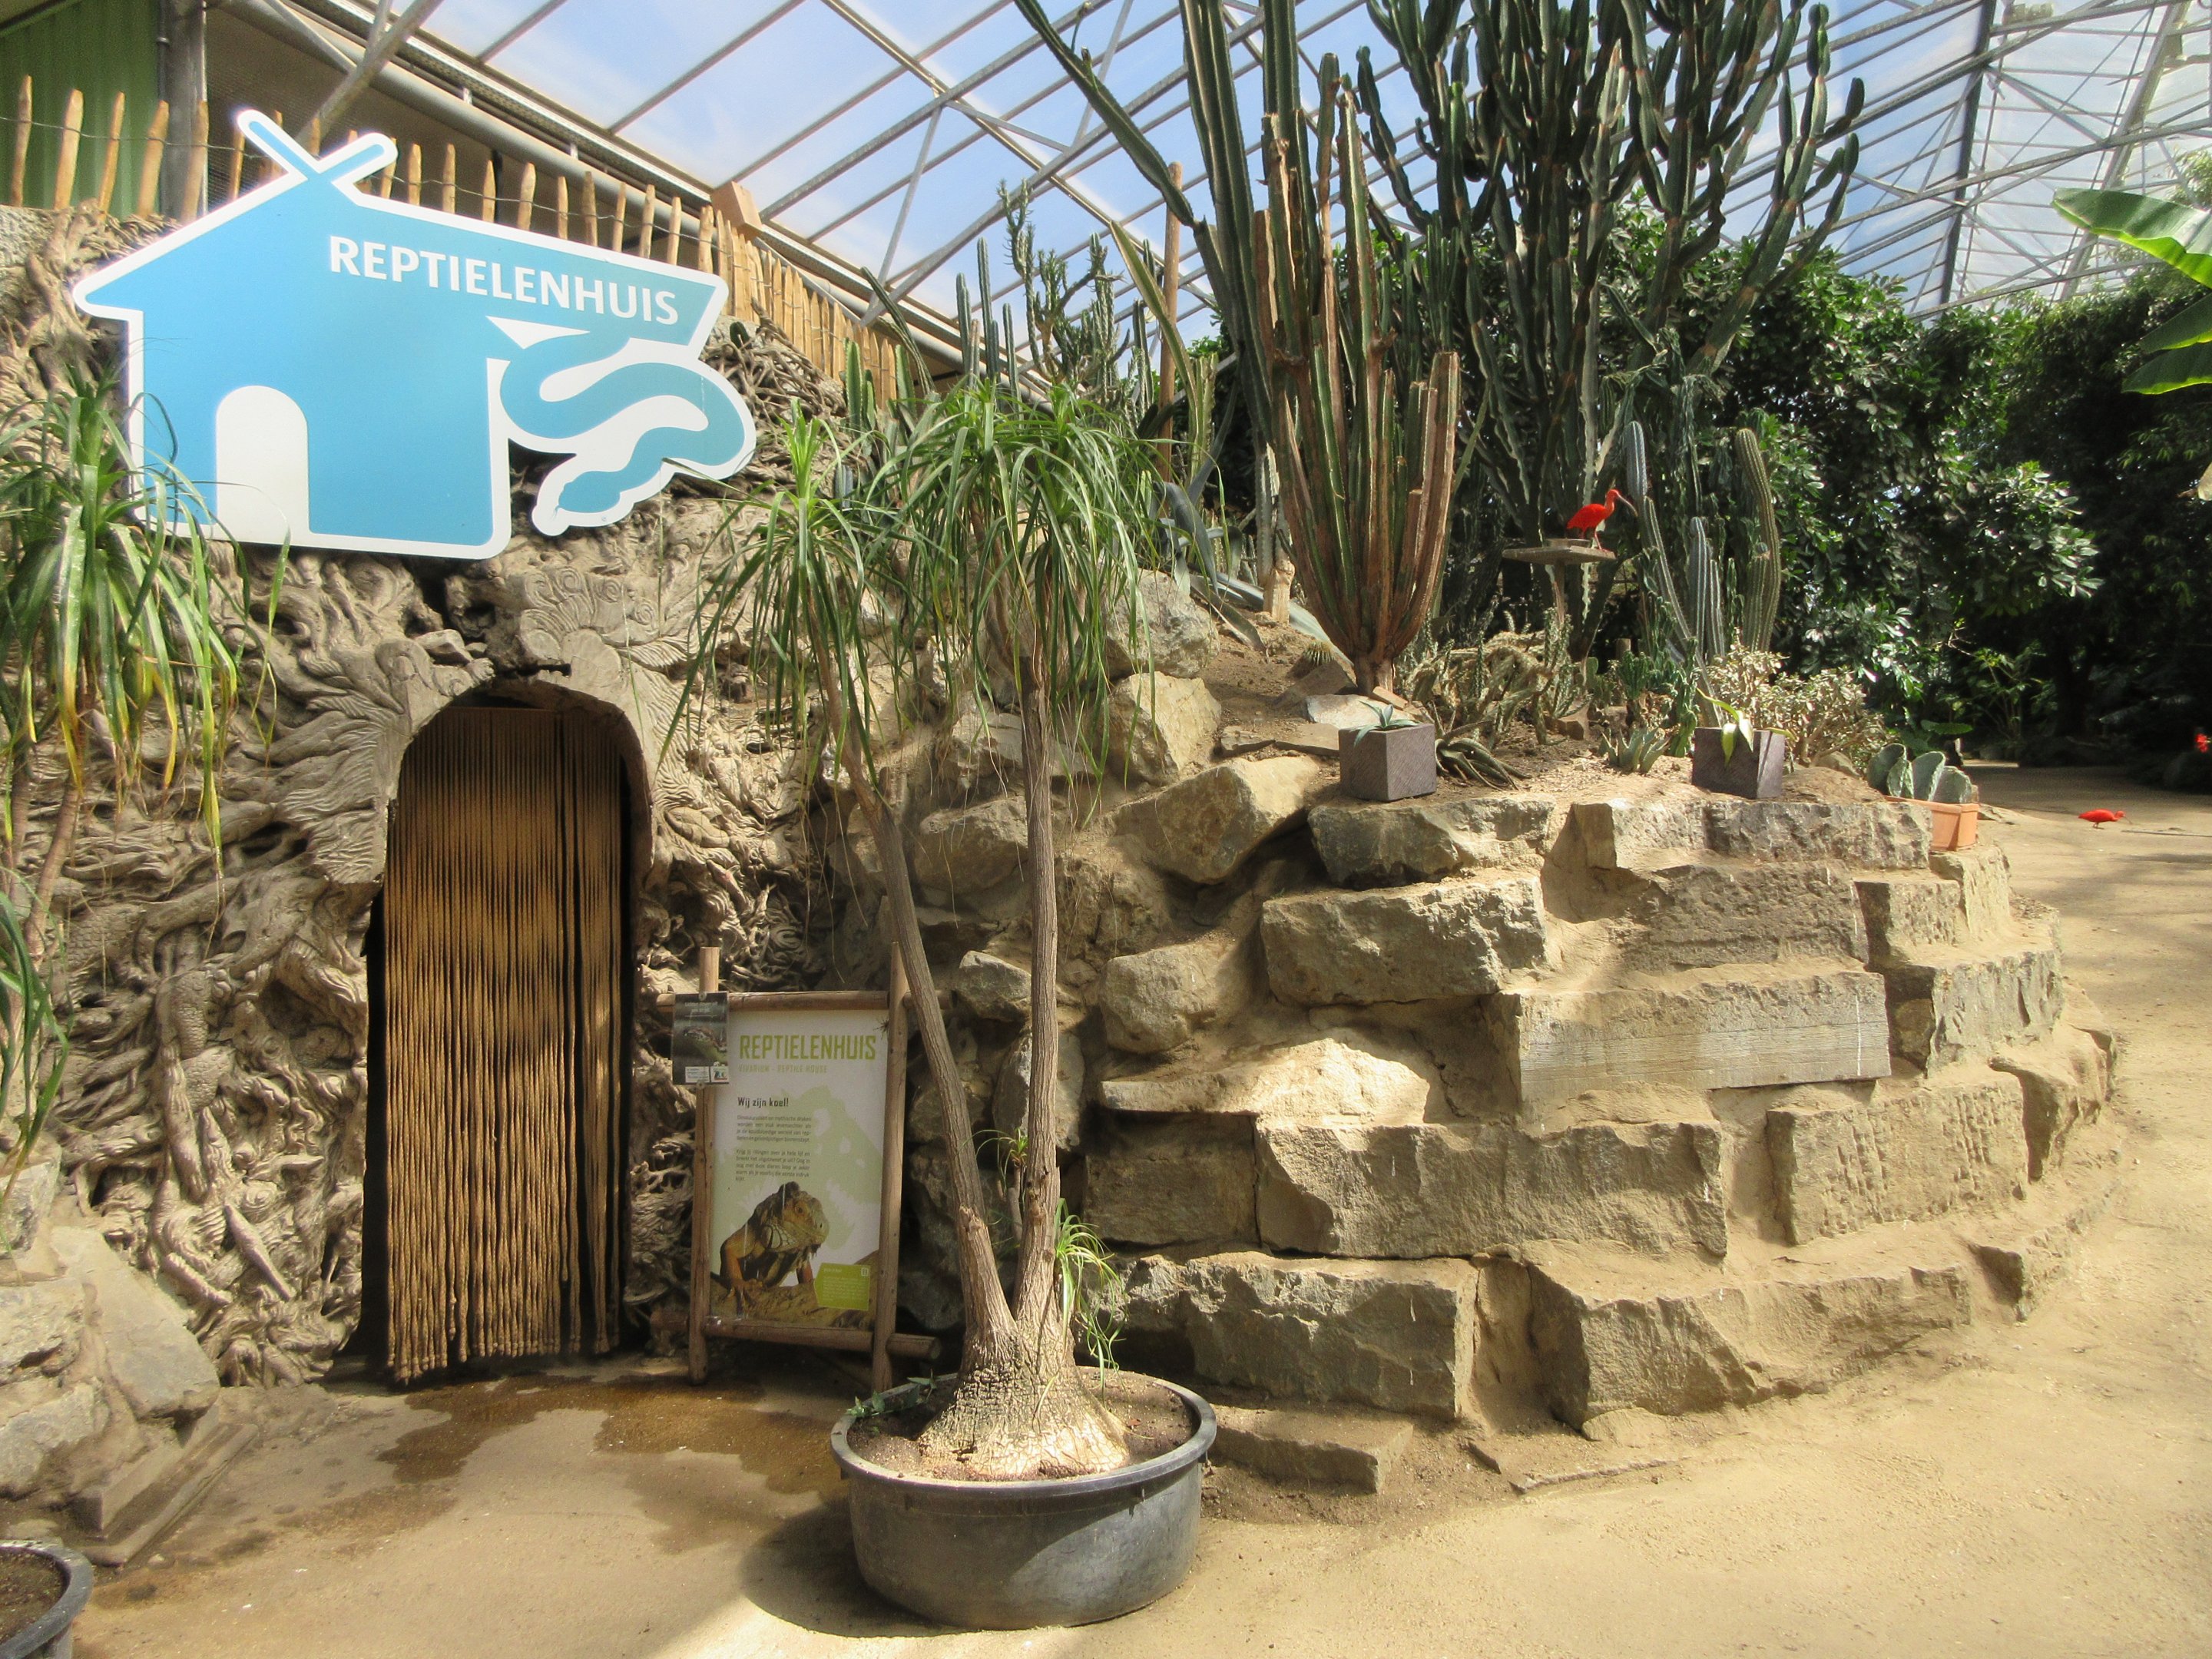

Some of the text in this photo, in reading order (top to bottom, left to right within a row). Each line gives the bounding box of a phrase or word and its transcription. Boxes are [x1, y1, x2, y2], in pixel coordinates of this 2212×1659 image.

[330, 236, 678, 325] REPTIELENHUIS
[740, 1035, 876, 1060] REPTIELENHUIS
[777, 1065, 803, 1073] REPTILE
[806, 1065, 827, 1074] HOUSE
[737, 1097, 789, 1108] Wij zijn koel!
